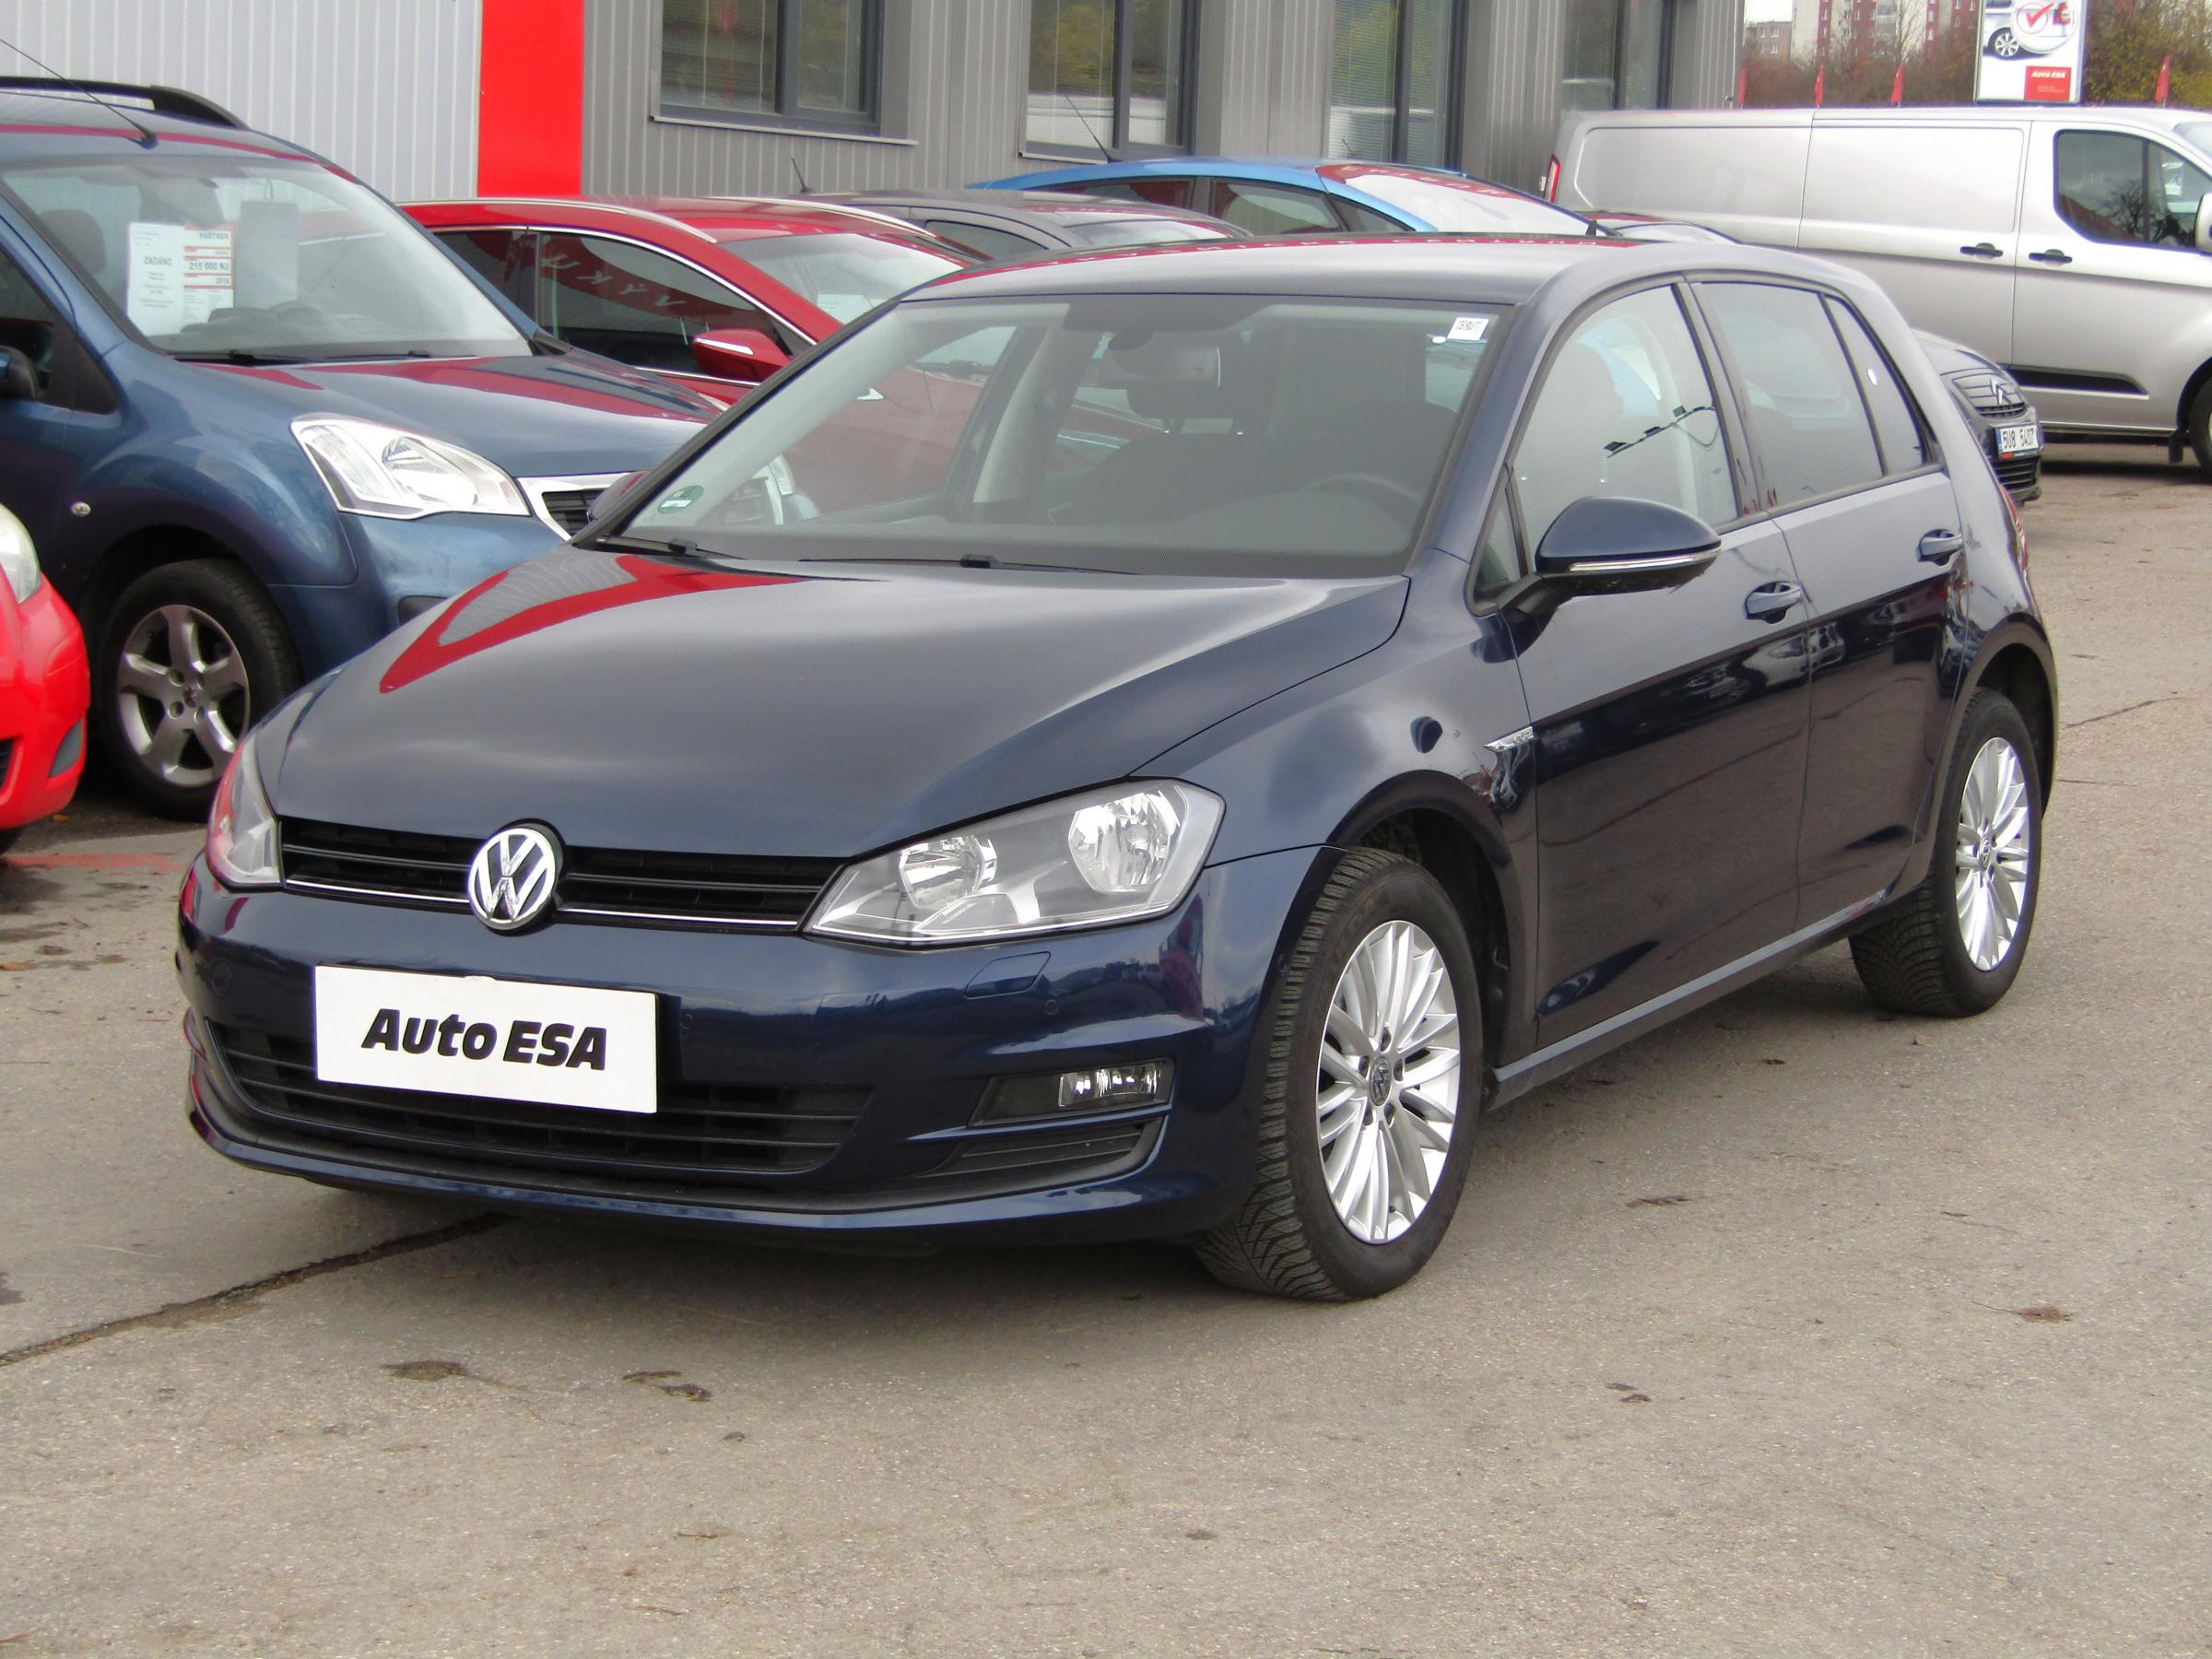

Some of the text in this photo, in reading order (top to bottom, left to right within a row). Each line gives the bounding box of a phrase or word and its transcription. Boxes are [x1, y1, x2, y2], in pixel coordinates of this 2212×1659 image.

[199, 232, 229, 241] PARTNER
[204, 262, 218, 270] 000
[2003, 429, 2017, 449] 5U8
[470, 828, 555, 928] VW
[360, 1007, 608, 1071] Auto ESA
